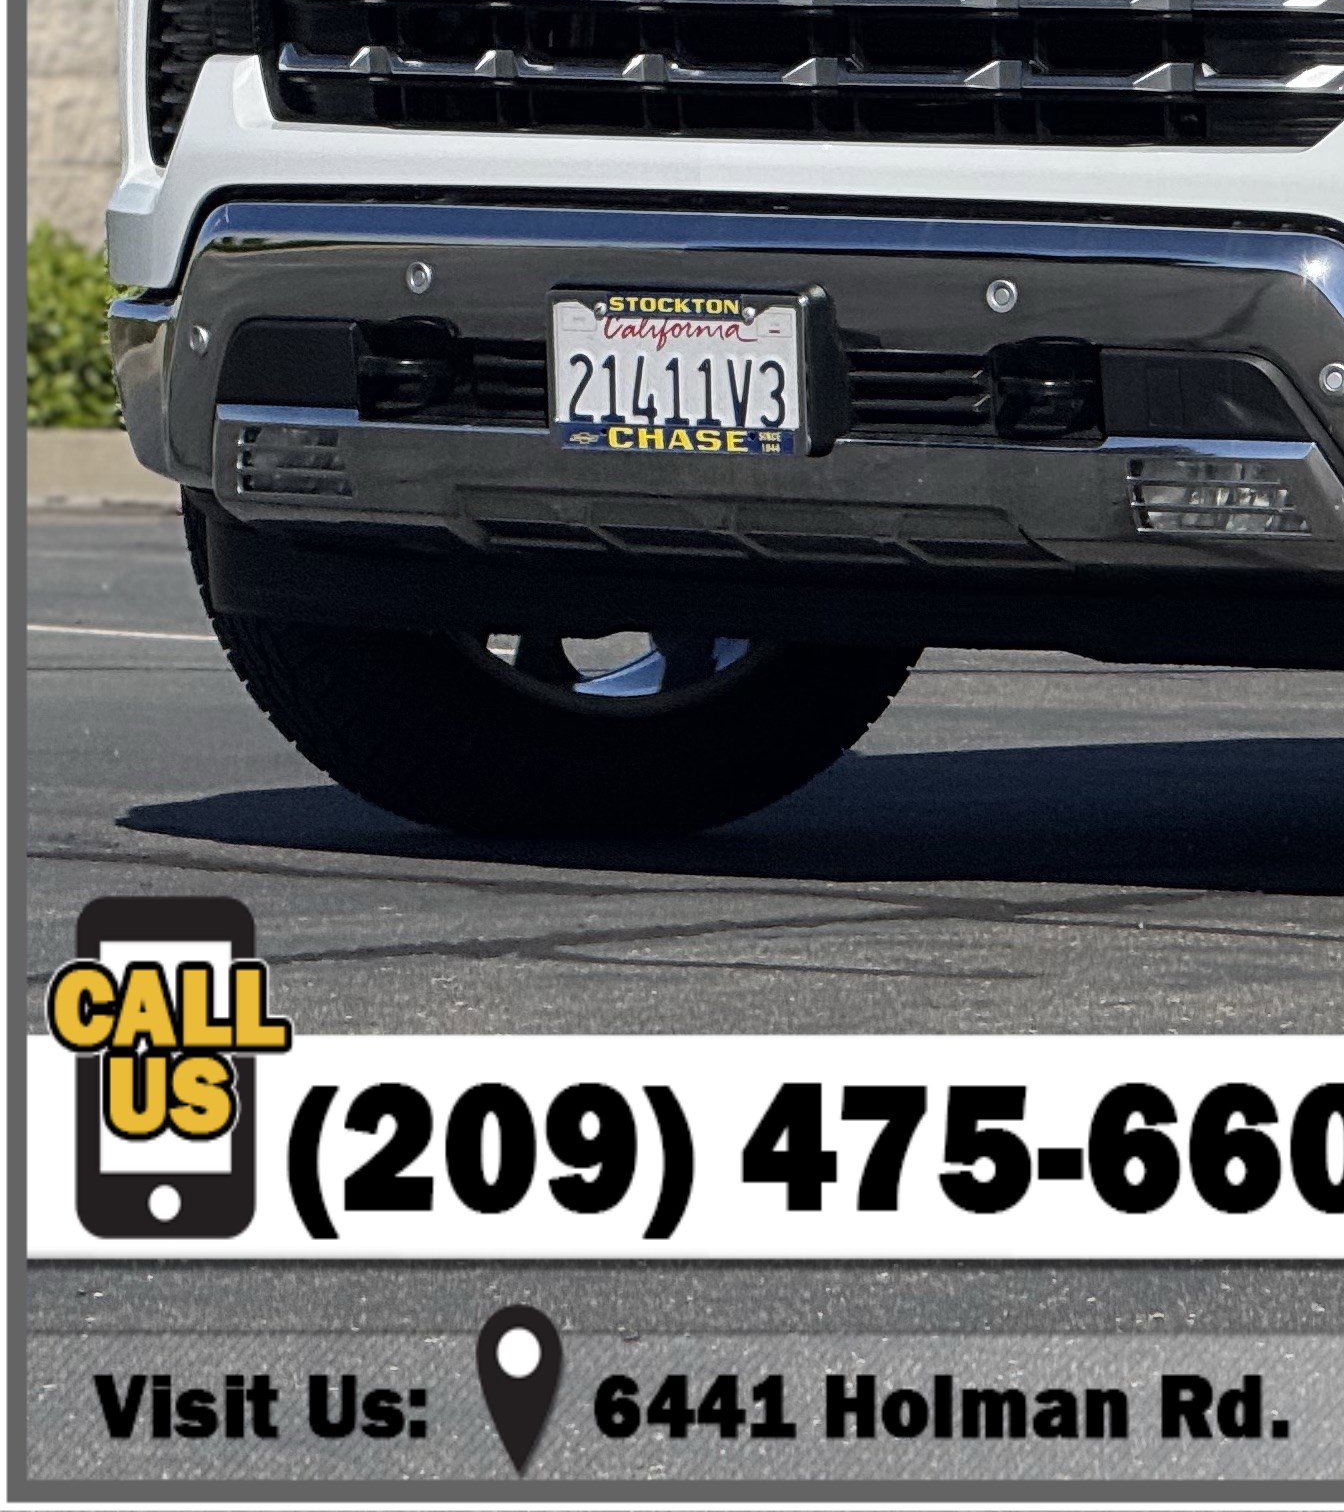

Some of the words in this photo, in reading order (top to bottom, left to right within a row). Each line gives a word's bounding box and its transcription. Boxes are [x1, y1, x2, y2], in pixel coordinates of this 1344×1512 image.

[609, 296, 740, 315] STOCKTON
[604, 316, 757, 351] California
[570, 354, 785, 428] 21411V3
[608, 427, 748, 453] CHASE
